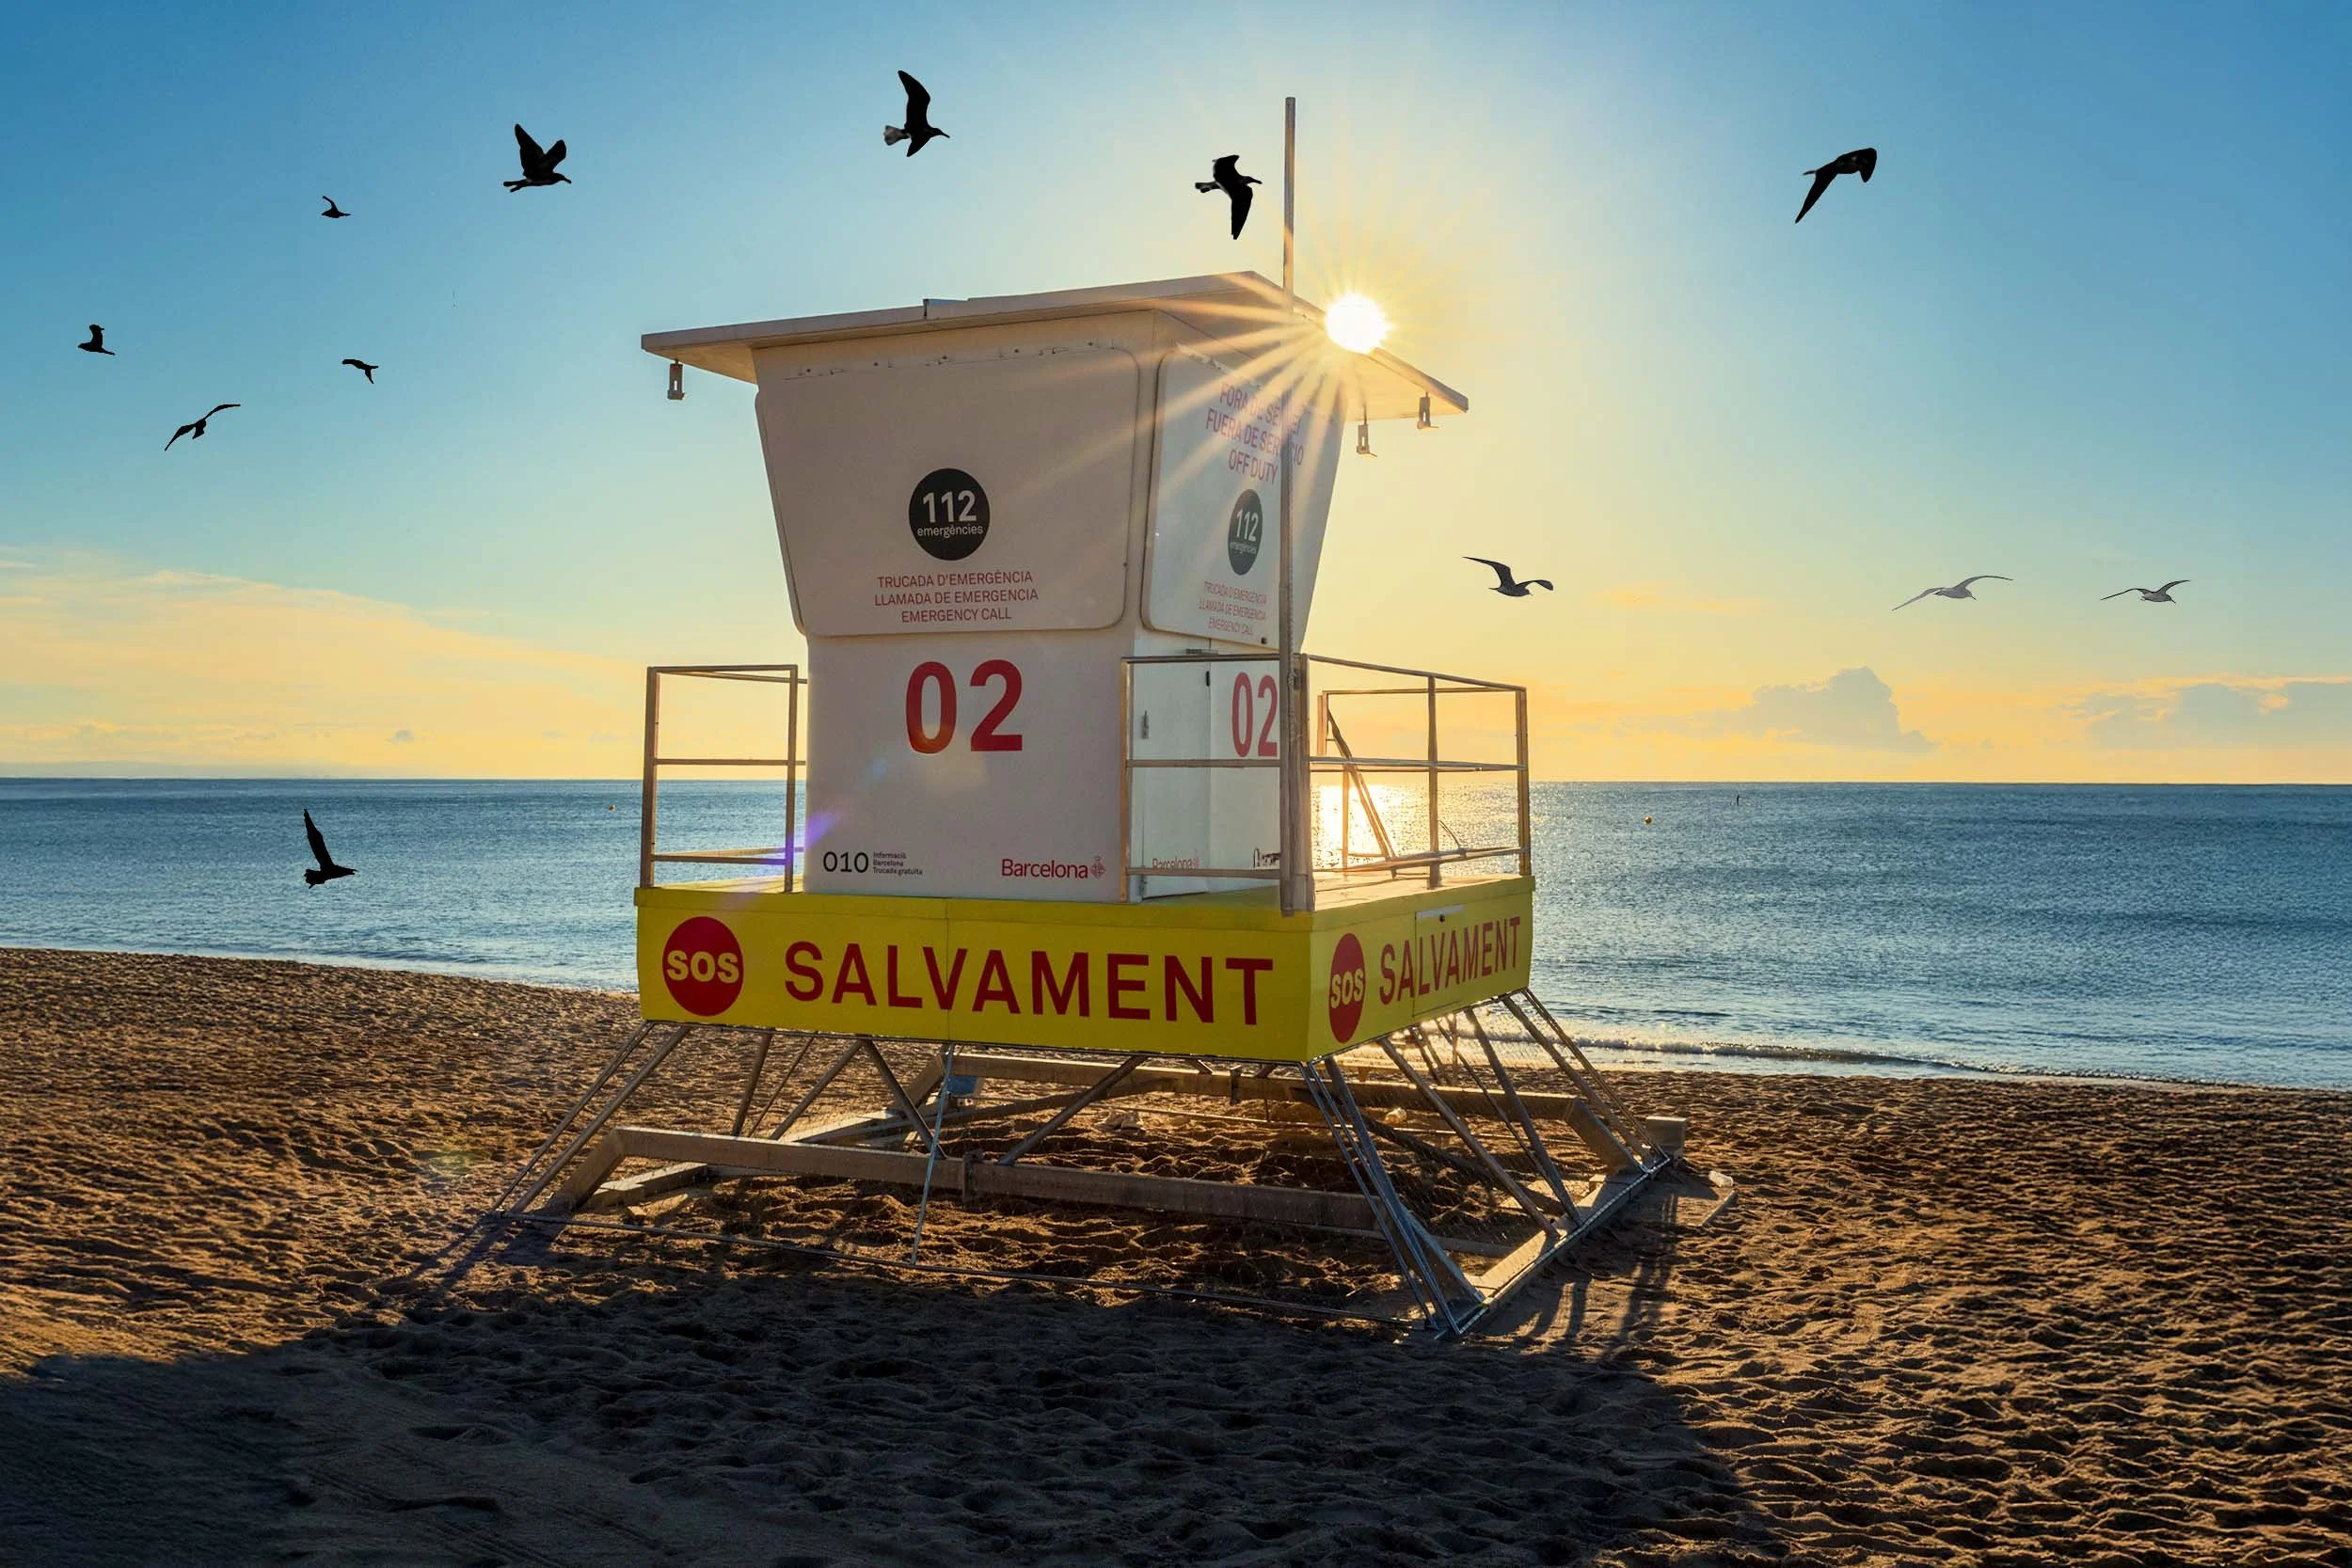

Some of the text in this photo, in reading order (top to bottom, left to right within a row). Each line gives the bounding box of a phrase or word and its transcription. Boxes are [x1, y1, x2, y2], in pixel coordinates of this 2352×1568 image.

[1244, 424, 1259, 449] DE
[1229, 449, 1279, 485] OFF DUTY
[922, 489, 977, 523] 112
[1236, 509, 1259, 542] 112
[878, 570, 1033, 588] TRUCADA D'EMERGÈNCIA
[874, 588, 1039, 606] LLAMADA DE EMERGENCIA
[901, 608, 1012, 623] EMERGENCY CALL
[905, 659, 1023, 753] 02
[1232, 672, 1278, 757] 02
[823, 851, 869, 873] 010
[1001, 858, 1089, 879] Barcelona
[667, 949, 739, 984] SOS
[1379, 916, 1520, 1006] SALVAMENT
[784, 941, 1273, 1025] SALVAMENT
[1330, 968, 1364, 1009] SOS
